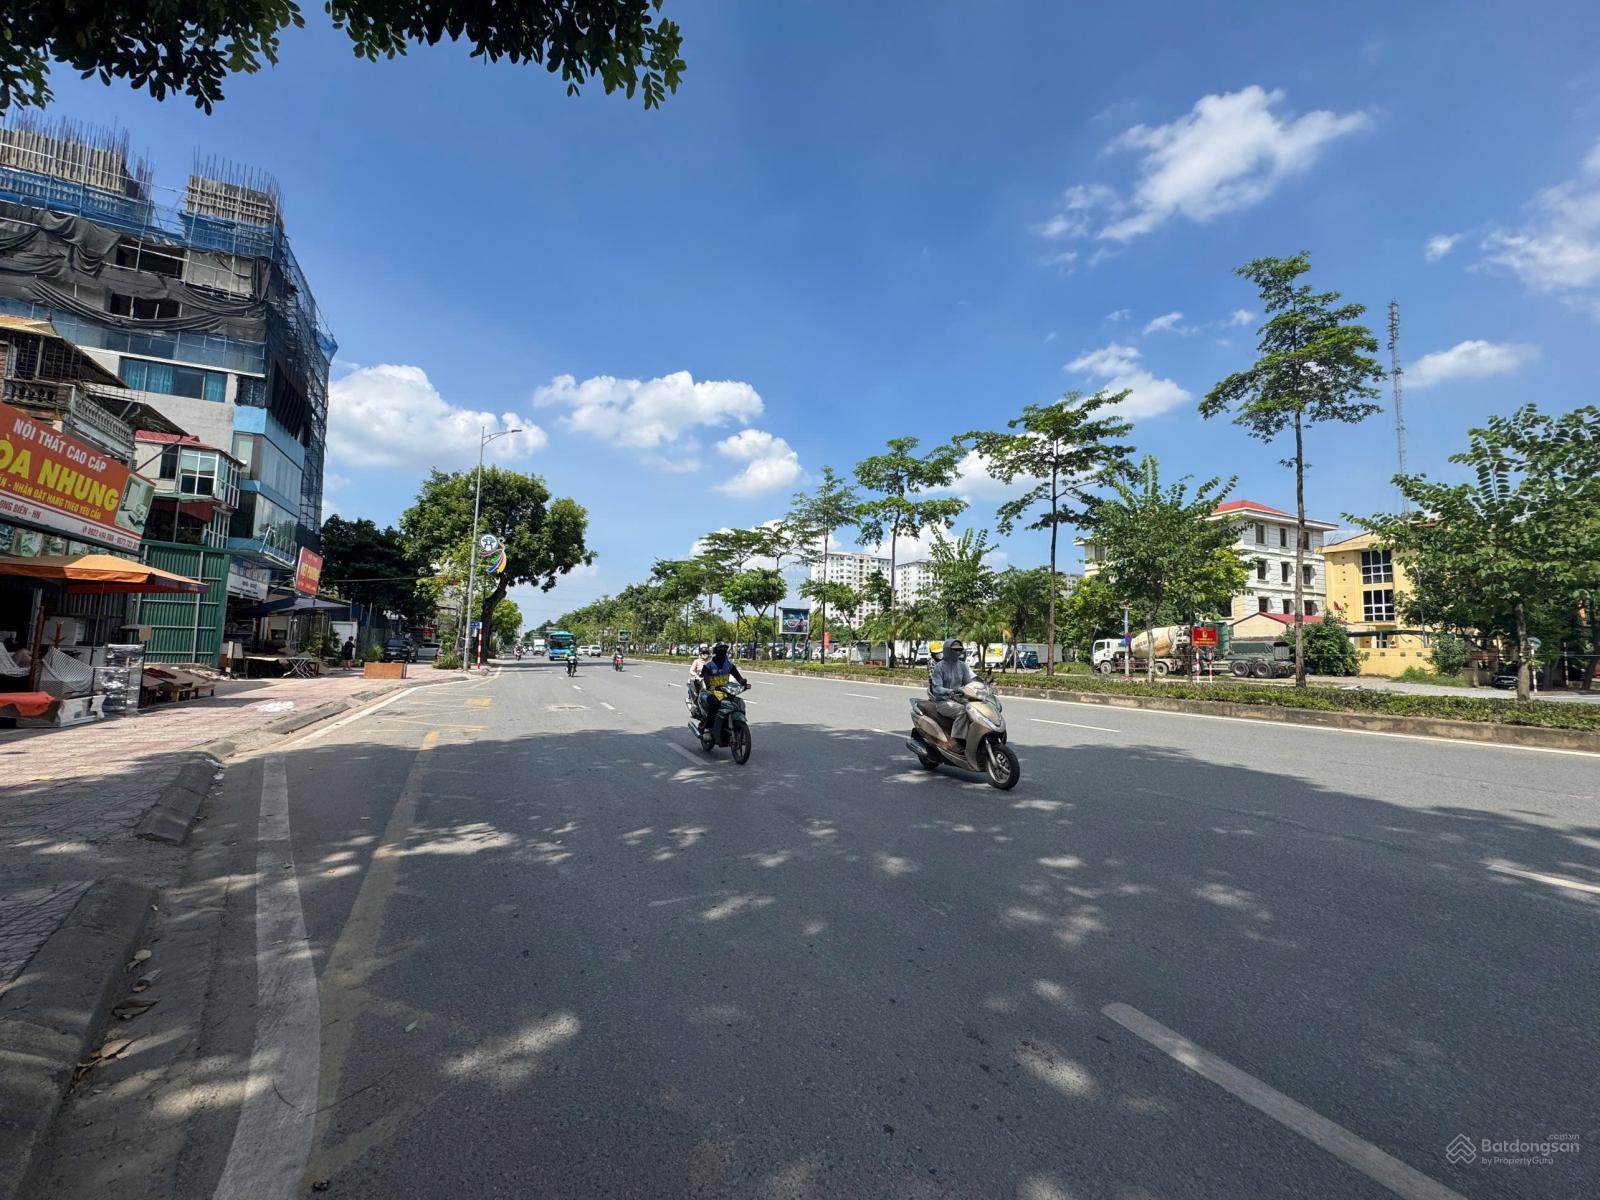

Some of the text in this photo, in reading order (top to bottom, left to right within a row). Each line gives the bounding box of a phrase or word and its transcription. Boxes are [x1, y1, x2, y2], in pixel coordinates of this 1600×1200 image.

[13, 418, 107, 473] NỘI THẤT CAO CẤP
[13, 481, 34, 496] NHẬN
[33, 488, 48, 502] ĐẶT
[37, 458, 119, 512] NHUNG
